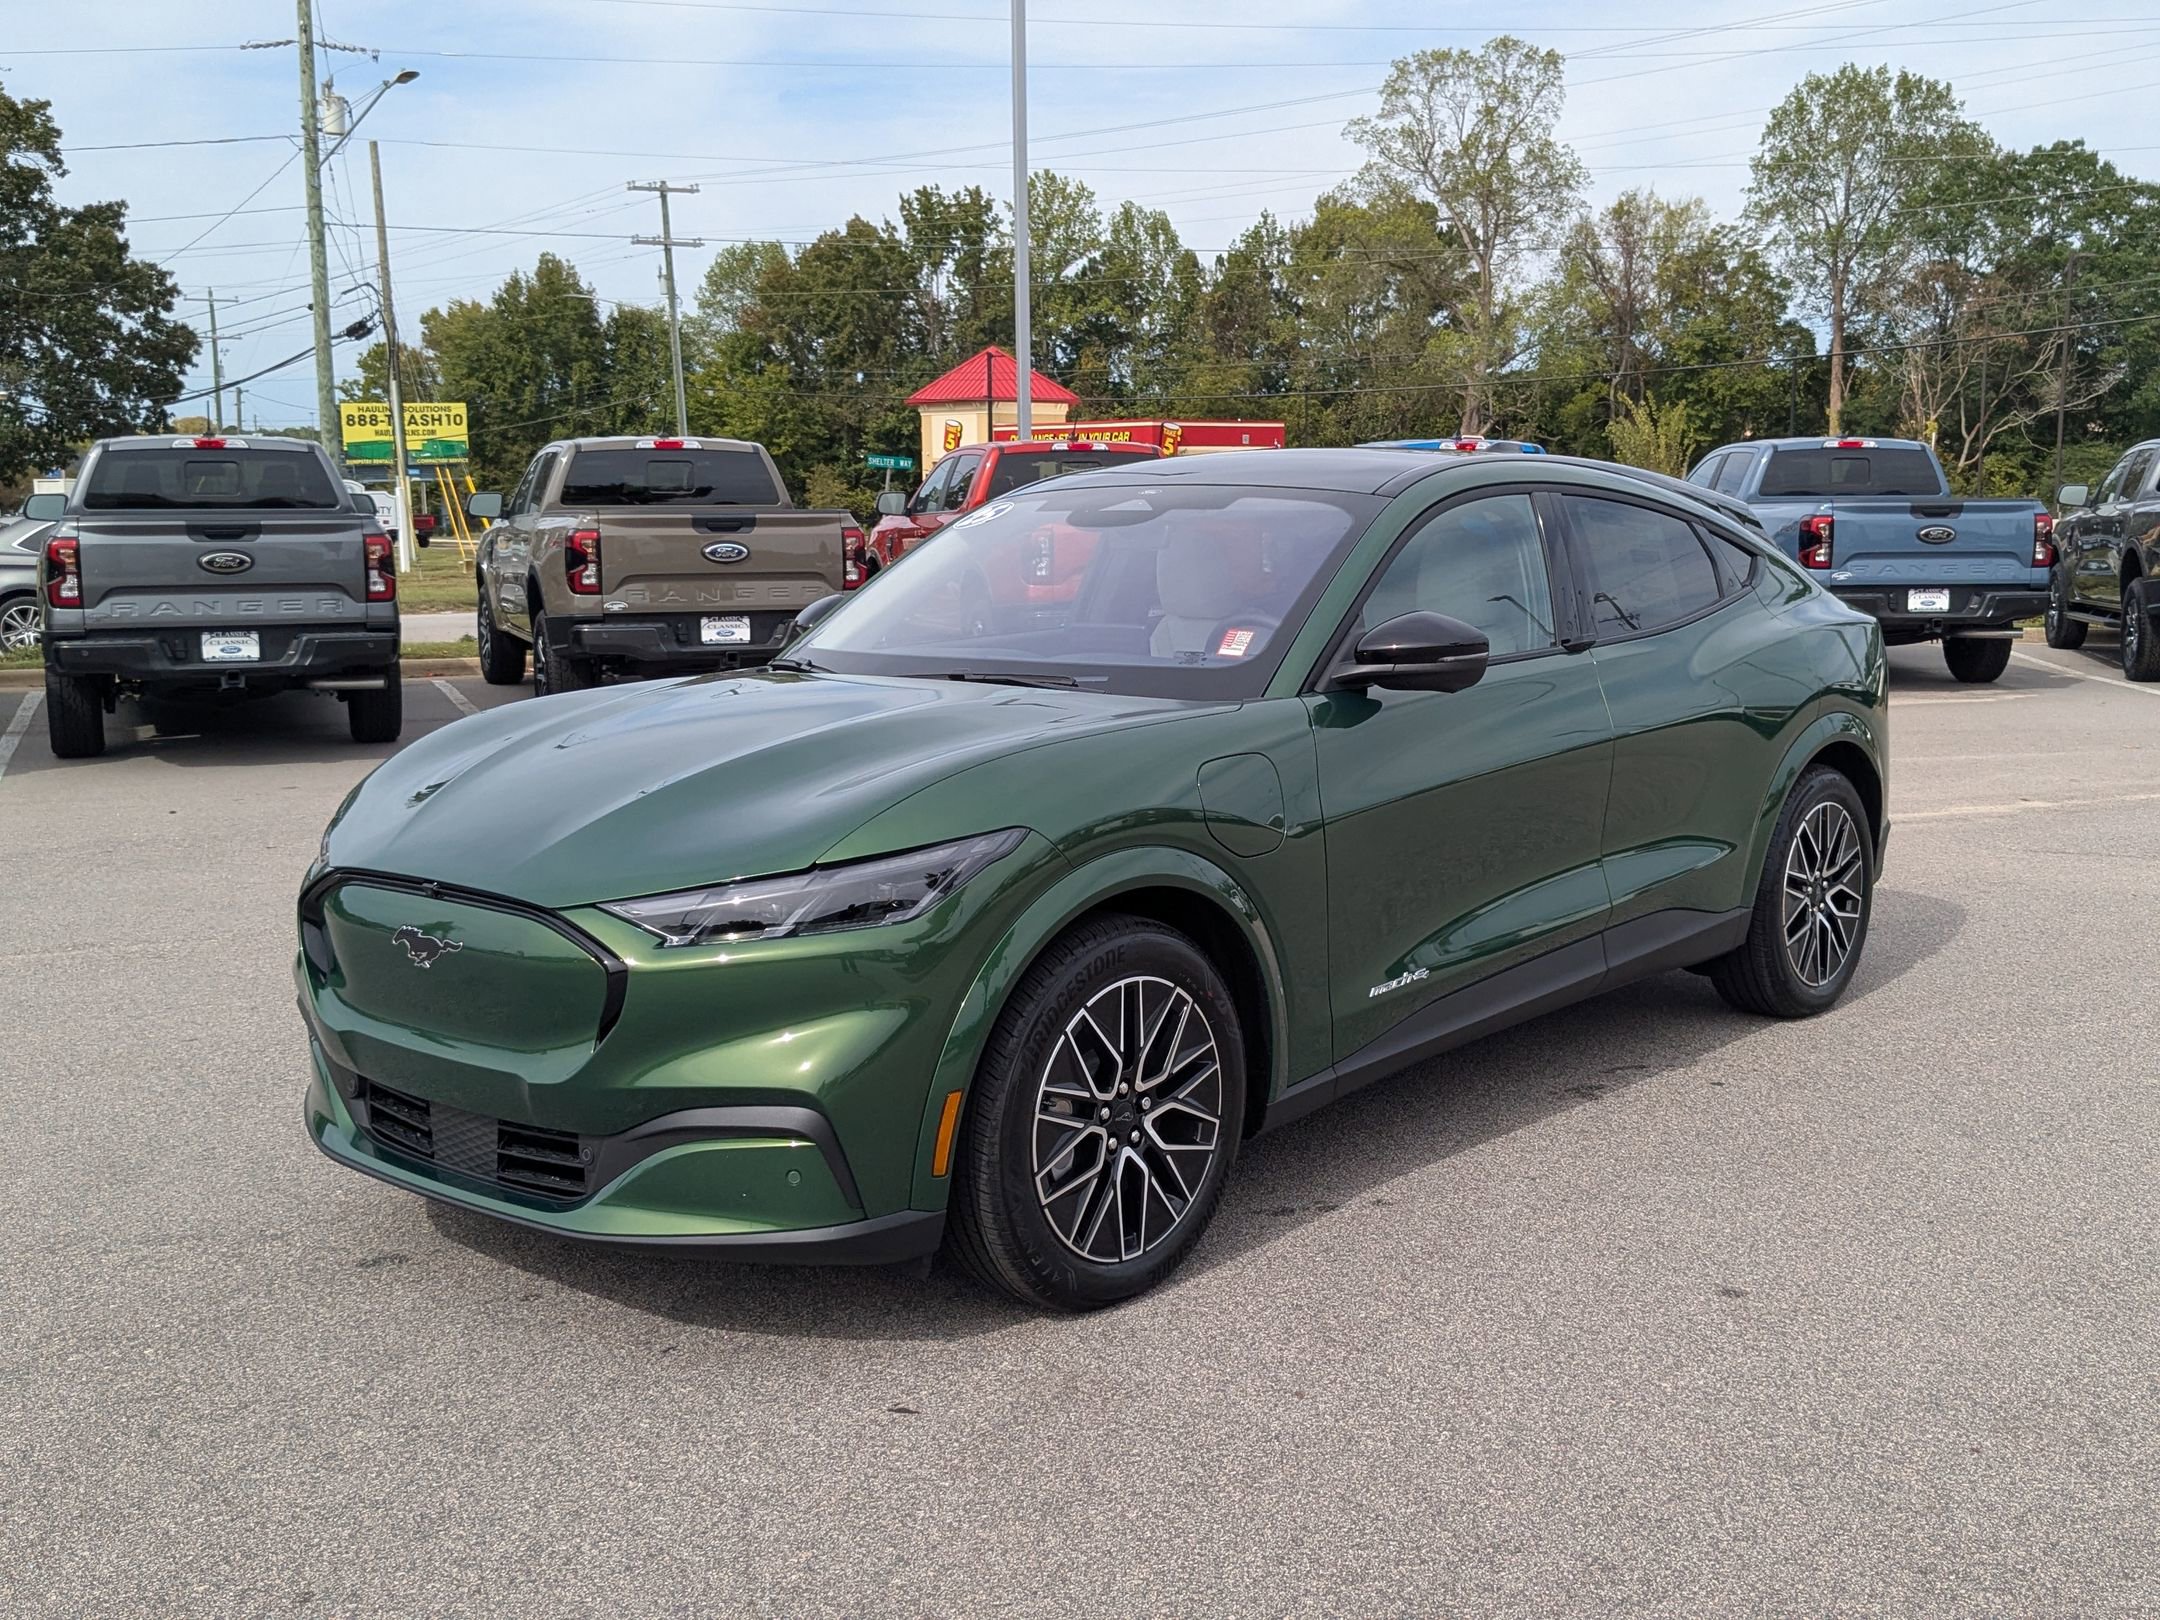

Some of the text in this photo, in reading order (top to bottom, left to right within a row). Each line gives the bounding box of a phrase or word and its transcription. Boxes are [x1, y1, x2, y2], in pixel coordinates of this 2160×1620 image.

[403, 405, 452, 413] SOLUTIONS
[346, 413, 464, 427] 888-TASH10
[945, 433, 955, 450] 5
[1111, 431, 1130, 442] CAR
[1163, 437, 1174, 456] 5
[868, 457, 895, 466] SHELTER
[1851, 563, 2017, 577] RANGER
[110, 599, 344, 618] RANGER
[1022, 944, 1127, 1072] BRIDGESTONE
